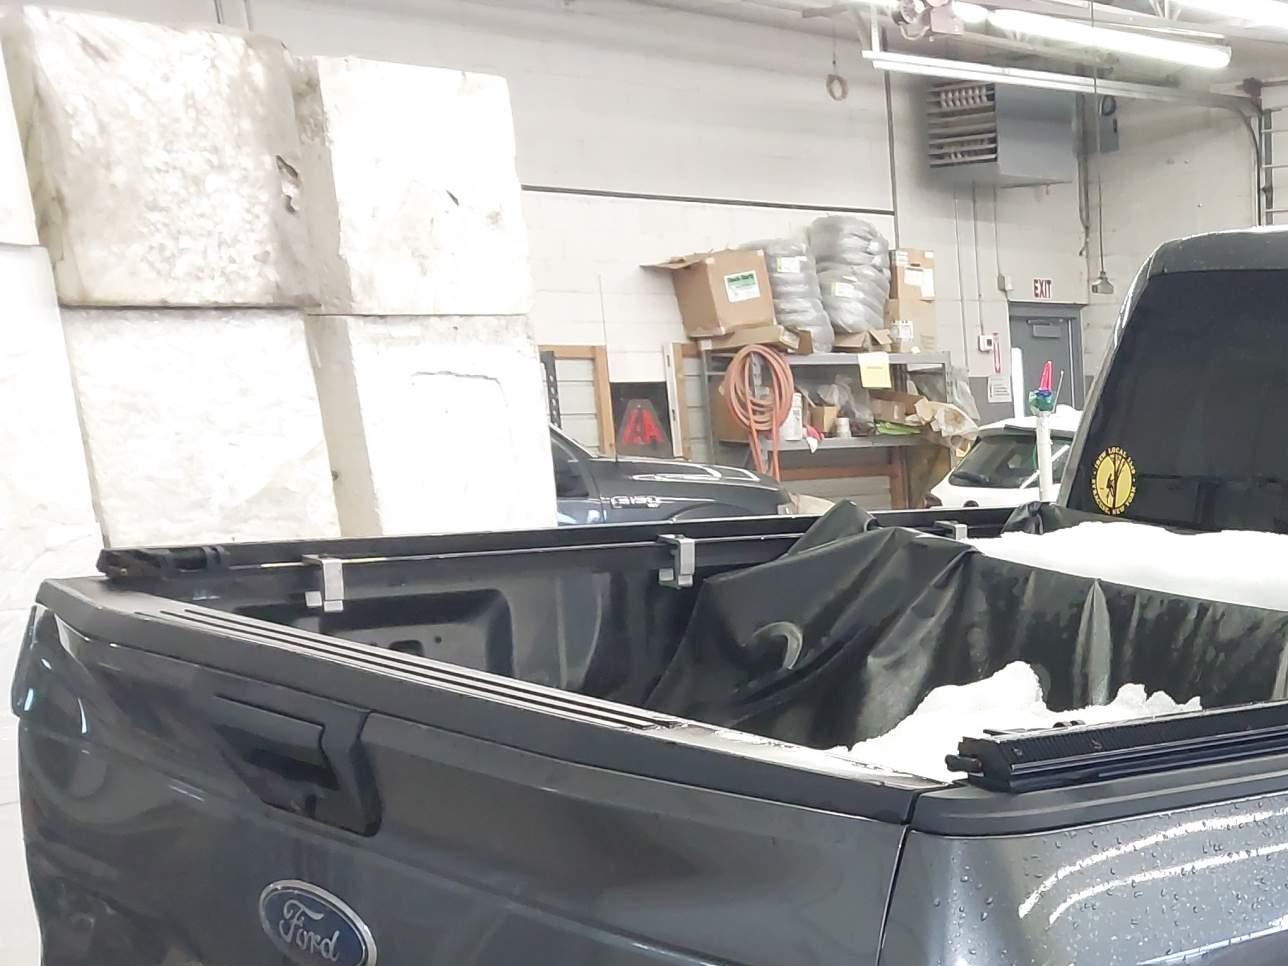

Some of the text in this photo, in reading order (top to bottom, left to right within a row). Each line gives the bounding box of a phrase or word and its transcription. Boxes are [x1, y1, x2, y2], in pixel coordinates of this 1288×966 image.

[1033, 279, 1052, 298] EXIT
[1108, 446, 1128, 458] LOCAL
[279, 899, 341, 962] Ford
